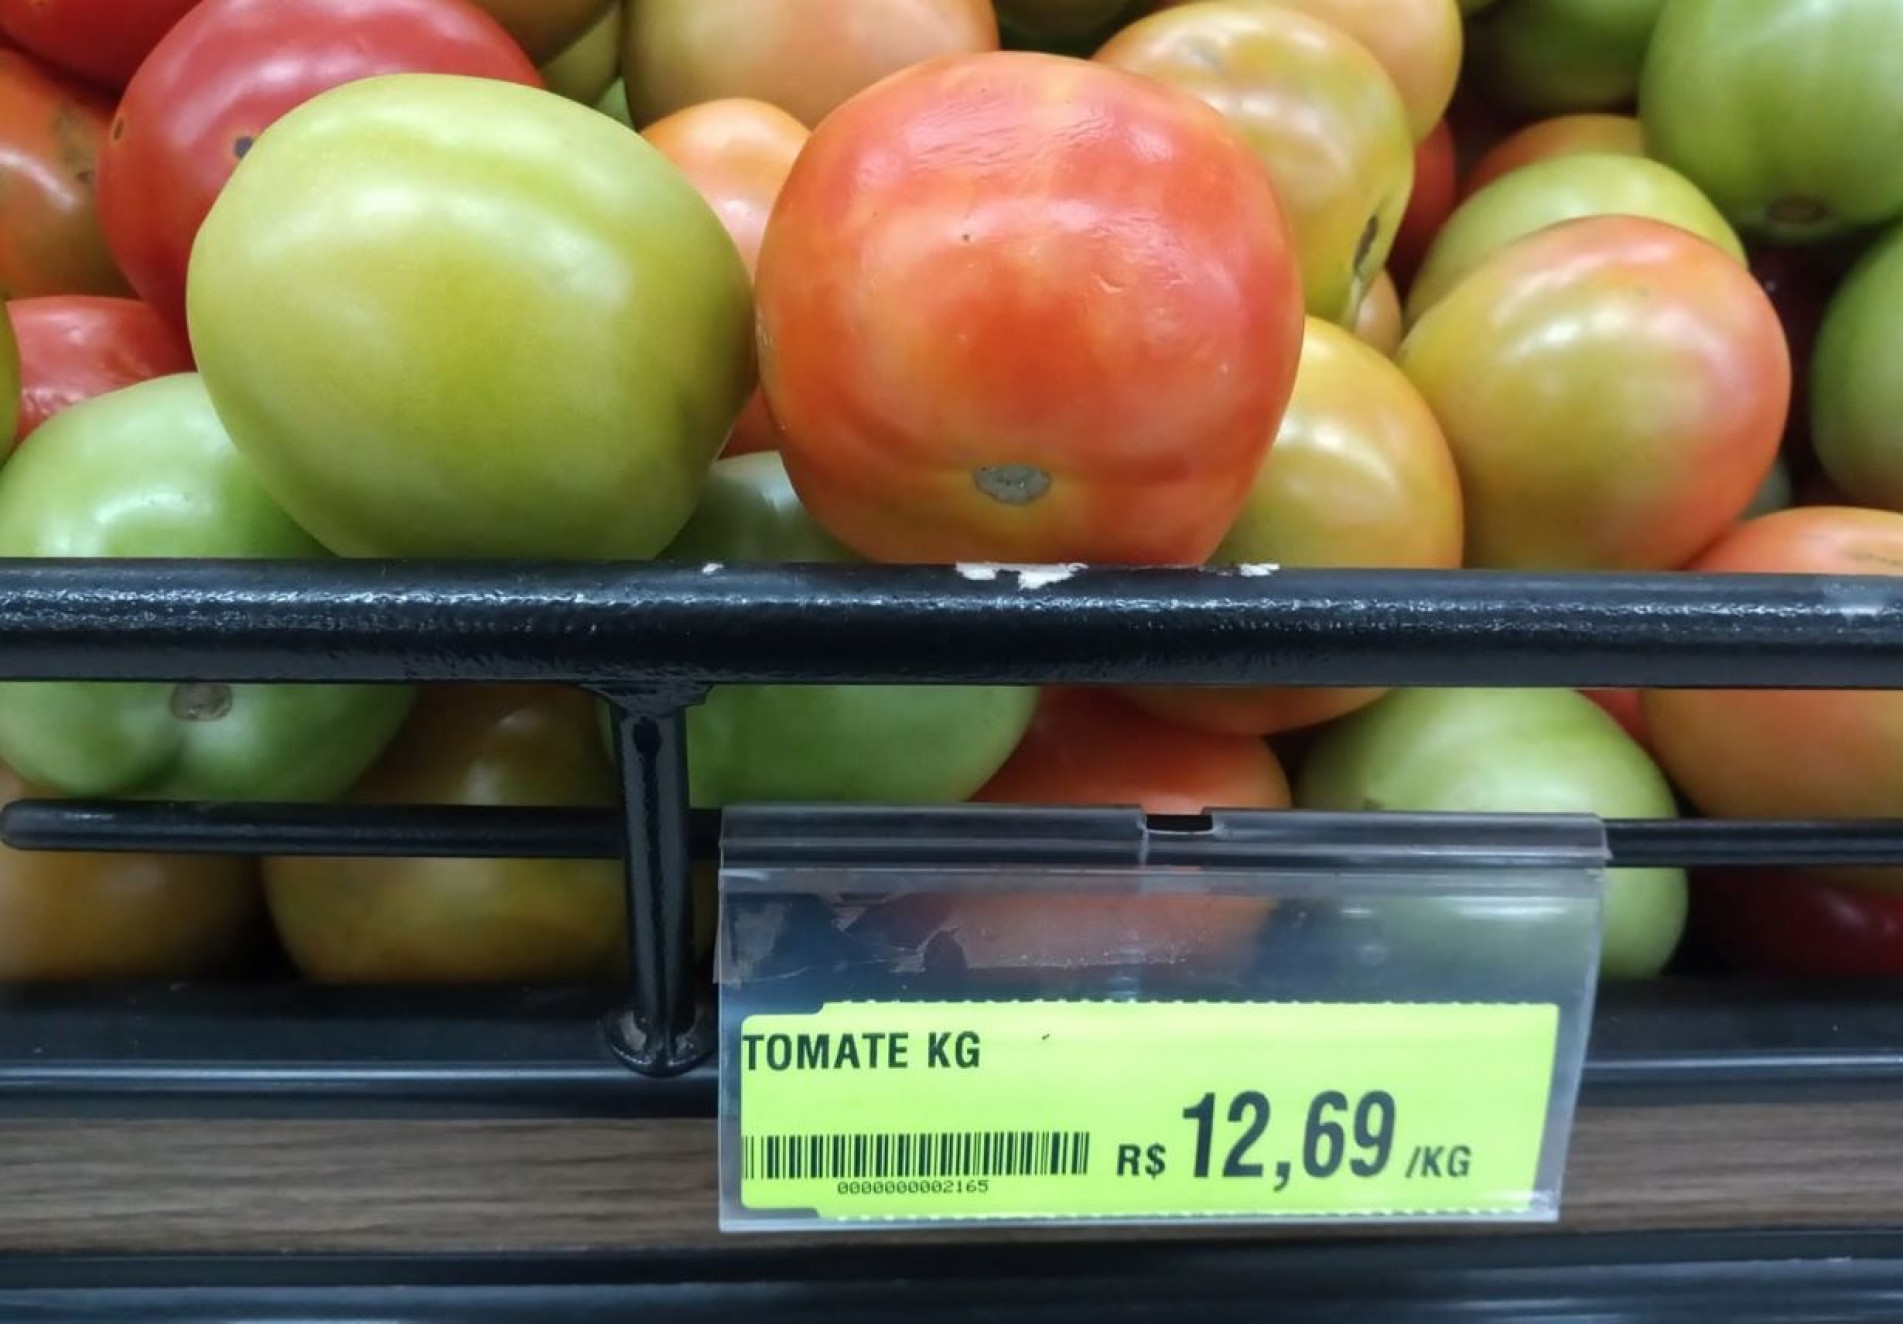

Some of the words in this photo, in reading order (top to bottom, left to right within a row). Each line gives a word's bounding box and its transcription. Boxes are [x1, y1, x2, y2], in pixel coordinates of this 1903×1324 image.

[742, 1032, 909, 1071] TOMATE
[927, 1031, 981, 1068] KG
[1116, 1142, 1166, 1179] R$
[1182, 1089, 1396, 1192] 12,69
[1405, 1145, 1472, 1178] /KG
[837, 1180, 989, 1195] 0000000002165
